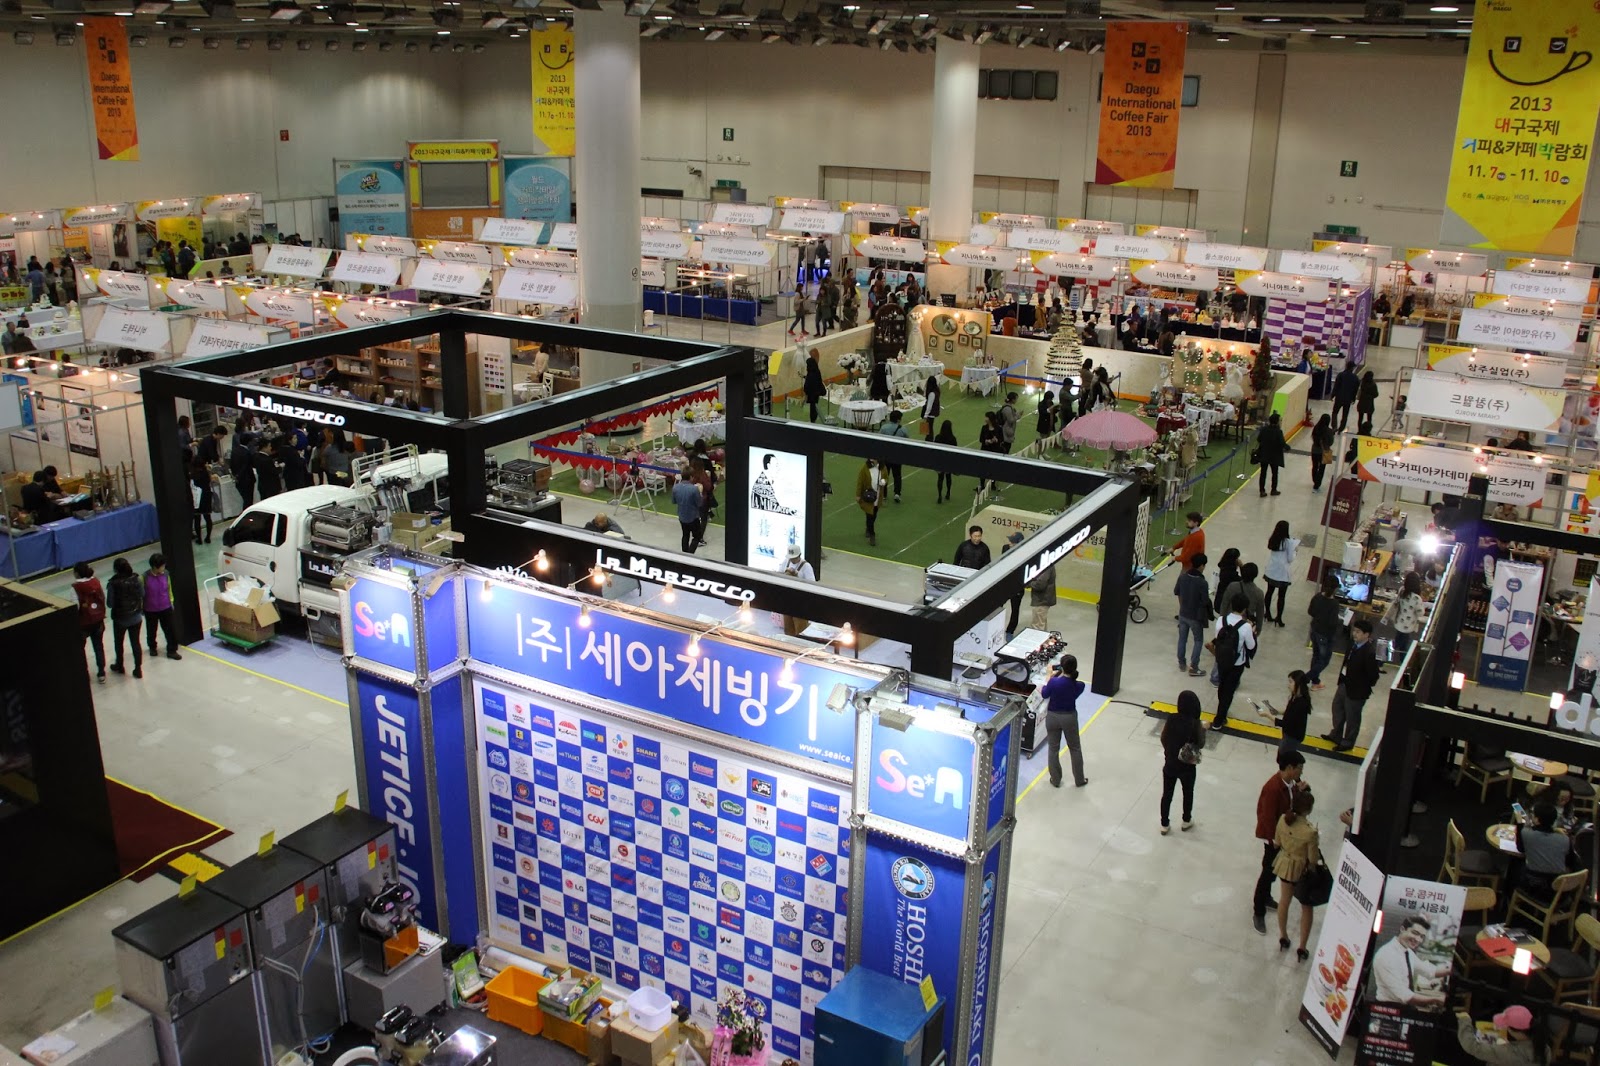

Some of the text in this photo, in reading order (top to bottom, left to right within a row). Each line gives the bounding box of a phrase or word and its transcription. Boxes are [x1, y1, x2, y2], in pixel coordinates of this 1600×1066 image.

[101, 72, 119, 83] Daegu
[550, 75, 566, 83] 2013
[94, 85, 130, 94] International
[1125, 82, 1160, 98] Daegu
[97, 96, 128, 106] Coffee Fair
[1107, 96, 1176, 110] International
[1509, 96, 1552, 112] 2013
[107, 108, 121, 117] 2013
[1110, 110, 1169, 124] Coffee Fair
[1126, 125, 1152, 137] 2013
[1495, 118, 1560, 136] 대구국제
[1462, 138, 1588, 162] 커피&카페박람회
[873, 244, 906, 253] 지니아트스쿨
[961, 253, 997, 263] 지니아트스쿨
[1056, 262, 1094, 272] 지니아트스쿨
[1156, 271, 1196, 282] 지니아트스쿨
[1262, 282, 1305, 293] 지니아트스쿨
[1506, 306, 1529, 314] 지리산
[1434, 346, 1451, 354] D-21
[1468, 363, 1530, 379] 상주실업(주)
[1366, 440, 1389, 450] D-13
[1383, 471, 1406, 480] Daegu
[1407, 475, 1431, 484] Coffee
[1502, 491, 1525, 499] coffee
[1332, 505, 1349, 514] offee
[992, 516, 1012, 527] 2013
[587, 813, 605, 825] CGV
[1341, 861, 1361, 887] HONEY
[574, 884, 584, 892] LG
[1338, 873, 1374, 914] GRAPEFRUIT
[1398, 898, 1449, 915] 특별 시음회
[893, 898, 906, 976] The World Best
[569, 951, 590, 963] posco
[971, 912, 991, 1046] HOSHIZAKI
